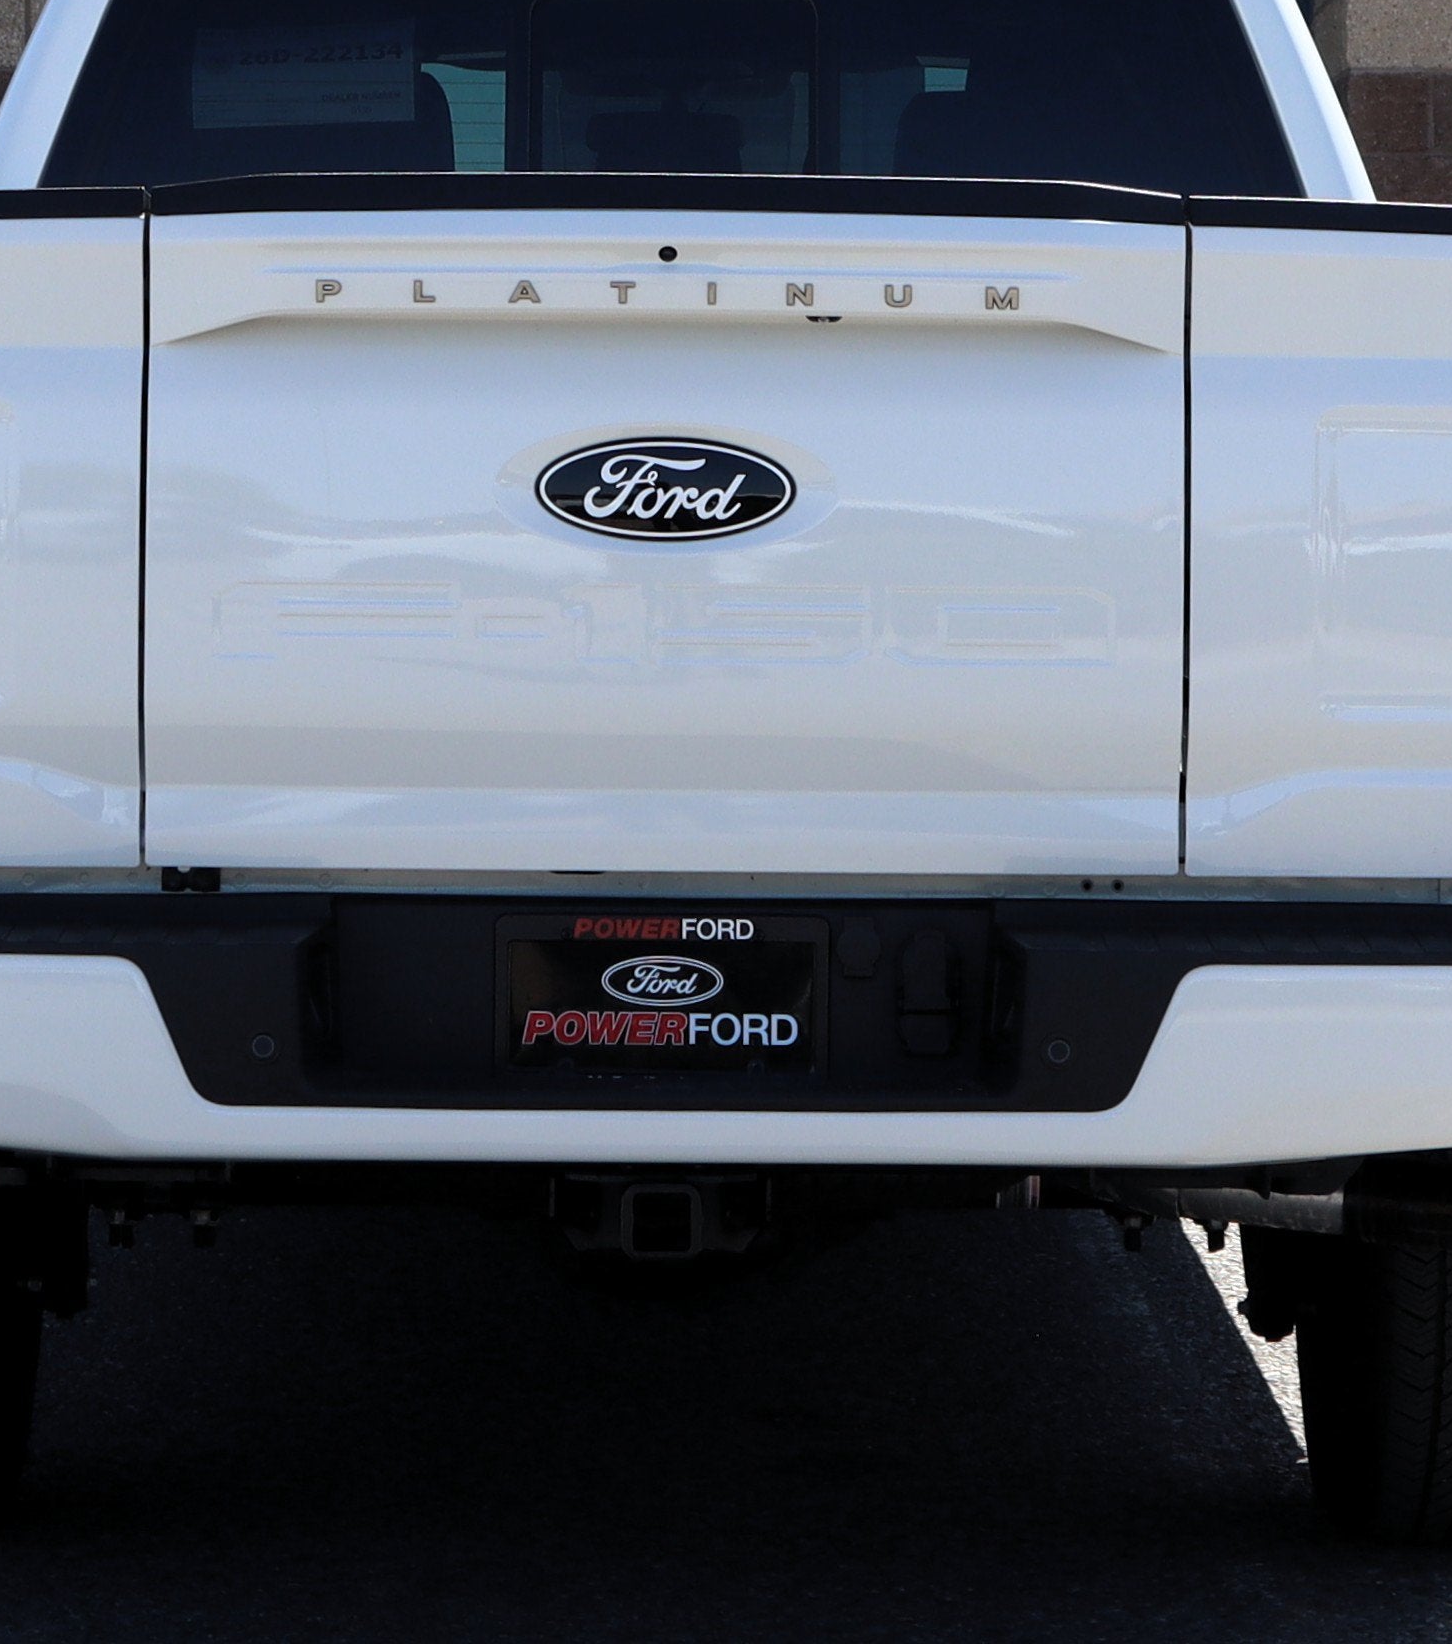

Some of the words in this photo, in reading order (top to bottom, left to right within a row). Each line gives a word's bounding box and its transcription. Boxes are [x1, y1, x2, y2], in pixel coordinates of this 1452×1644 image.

[315, 278, 1020, 312] PLATINUM
[584, 452, 743, 522] Ford
[626, 964, 698, 995] Ford
